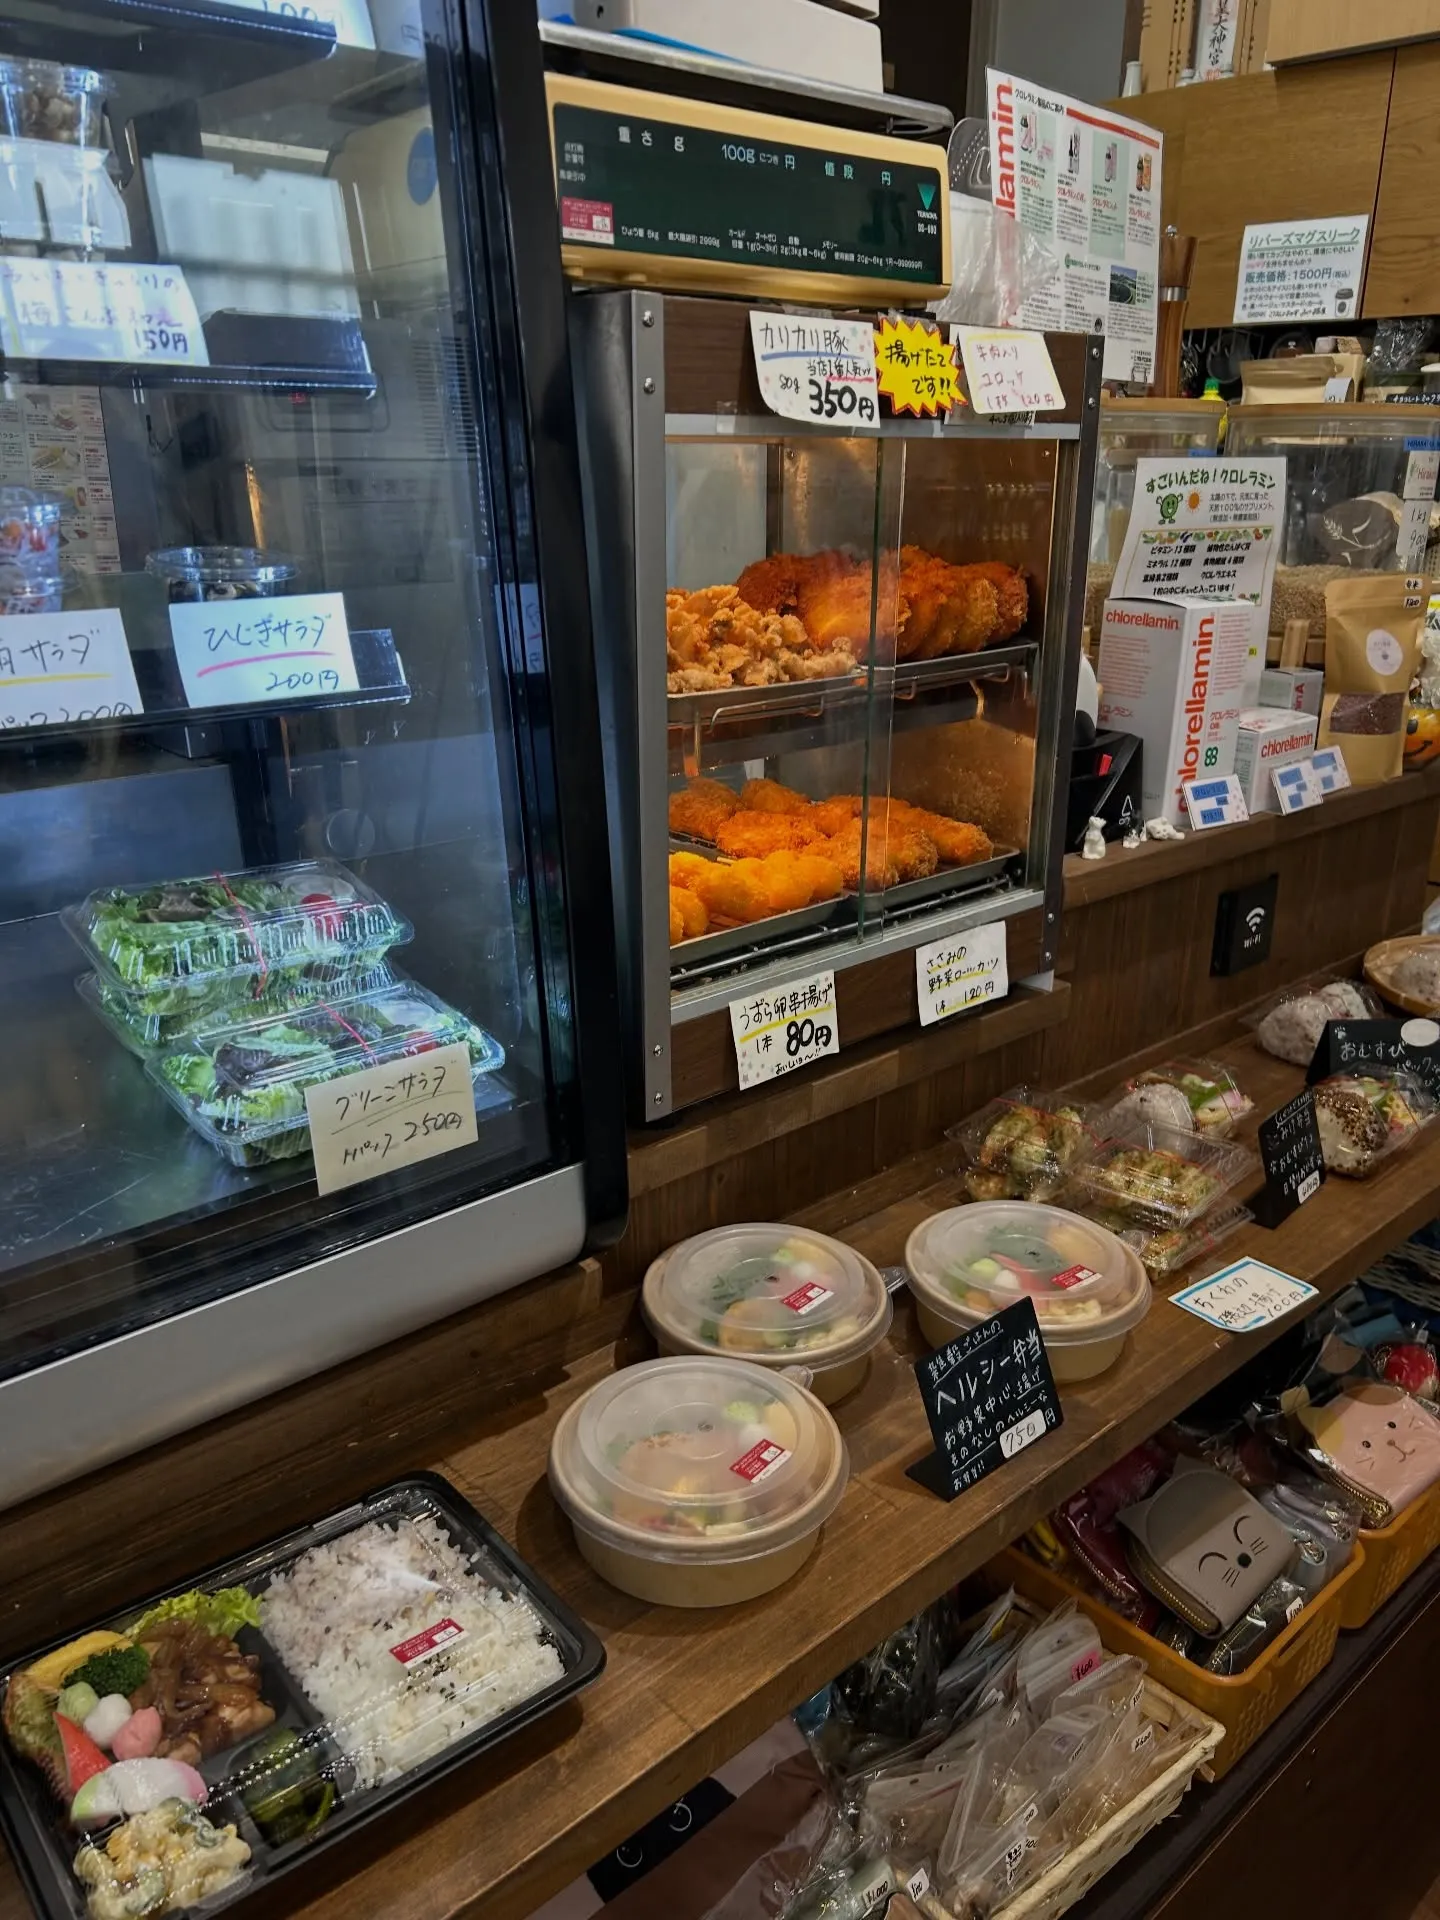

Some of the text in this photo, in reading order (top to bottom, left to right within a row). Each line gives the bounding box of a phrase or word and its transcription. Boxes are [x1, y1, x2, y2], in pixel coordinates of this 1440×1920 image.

[674, 136, 685, 152] g
[721, 143, 756, 165] 100g
[784, 154, 795, 171] 円
[992, 84, 1015, 217] lamin
[881, 170, 891, 187] 円
[1249, 227, 1361, 249] リバーズマグスリーク
[759, 322, 849, 355] カリカリ豚
[976, 344, 1018, 361] 牛肉入り
[885, 343, 947, 369] 揚げたて
[981, 370, 1024, 387] コロッケ
[808, 379, 875, 422] 350円
[1105, 609, 1179, 631] chlorellamin
[265, 668, 339, 693] 200円
[1261, 730, 1314, 758] chlorellamin
[926, 945, 967, 968] ささみの
[963, 980, 995, 1004] 120円
[739, 983, 834, 1031] うずら卵串揚げ
[756, 1018, 832, 1056] 1本 80円
[1340, 1039, 1409, 1062] おむすび
[335, 1059, 457, 1121] グリーンサラダ
[404, 1111, 463, 1143] 250円
[1193, 1276, 1249, 1311] ちくわの
[1269, 1291, 1304, 1319] 100円
[937, 1329, 1042, 1415] ヘルシー弁当
